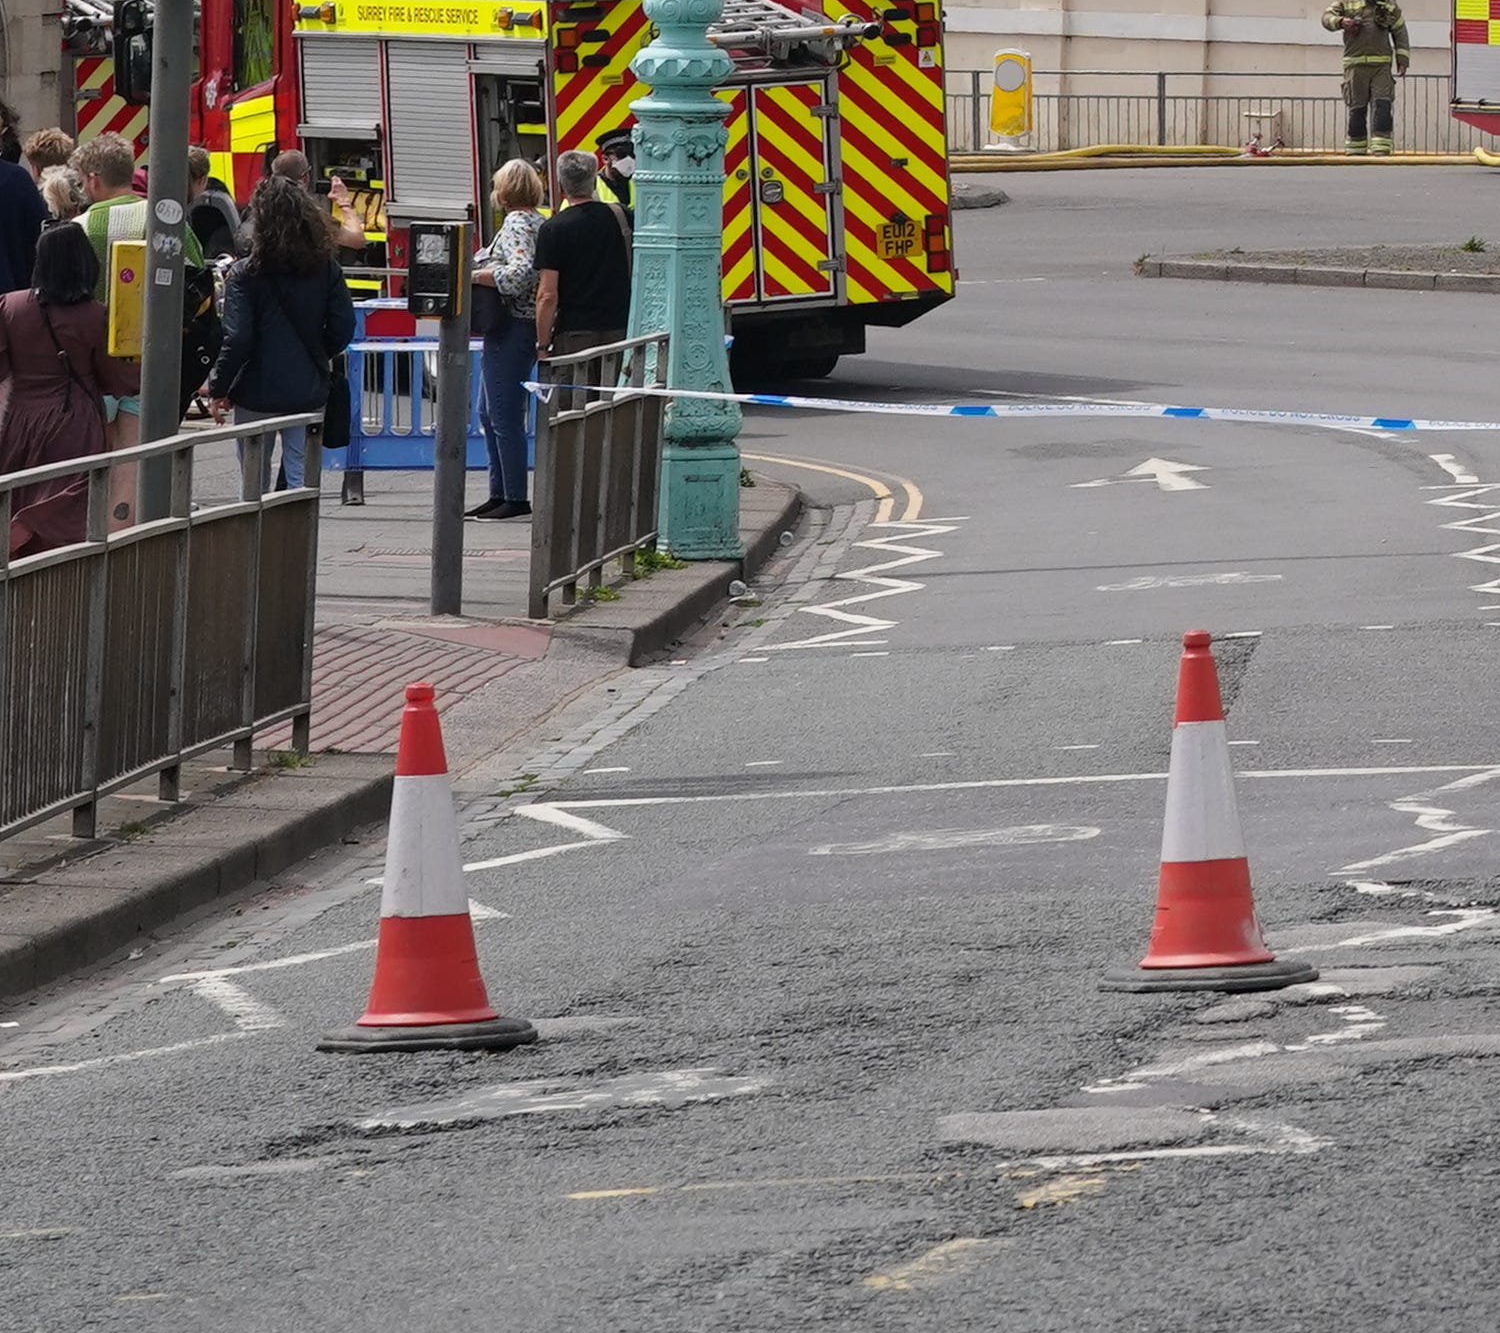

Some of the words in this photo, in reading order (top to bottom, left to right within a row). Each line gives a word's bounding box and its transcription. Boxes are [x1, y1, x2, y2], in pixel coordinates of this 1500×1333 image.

[357, 5, 387, 22] SURREY
[388, 6, 406, 22] FIRE
[407, 7, 413, 22] &
[413, 7, 444, 23] RESCUE
[445, 9, 479, 25] SERVICE
[882, 223, 915, 239] EU12
[885, 239, 914, 256] FHP
